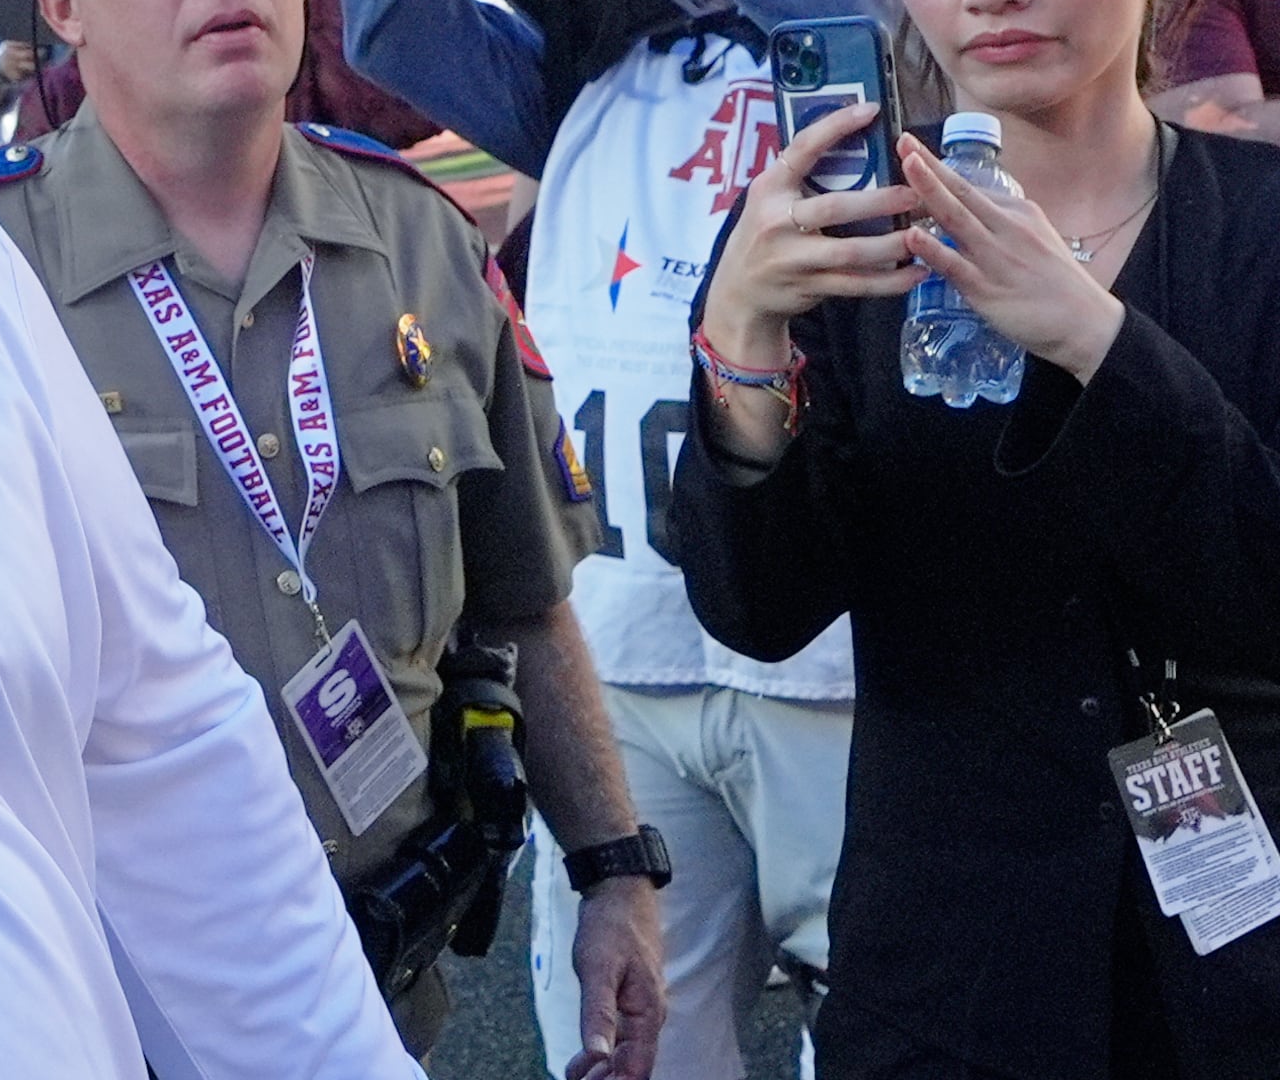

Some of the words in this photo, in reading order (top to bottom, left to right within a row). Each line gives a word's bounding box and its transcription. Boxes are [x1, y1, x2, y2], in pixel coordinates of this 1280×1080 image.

[132, 263, 184, 325] XAS
[200, 393, 285, 544] FOOTBALL
[301, 441, 335, 541] TEXAS
[1125, 744, 1221, 813] STAFF
